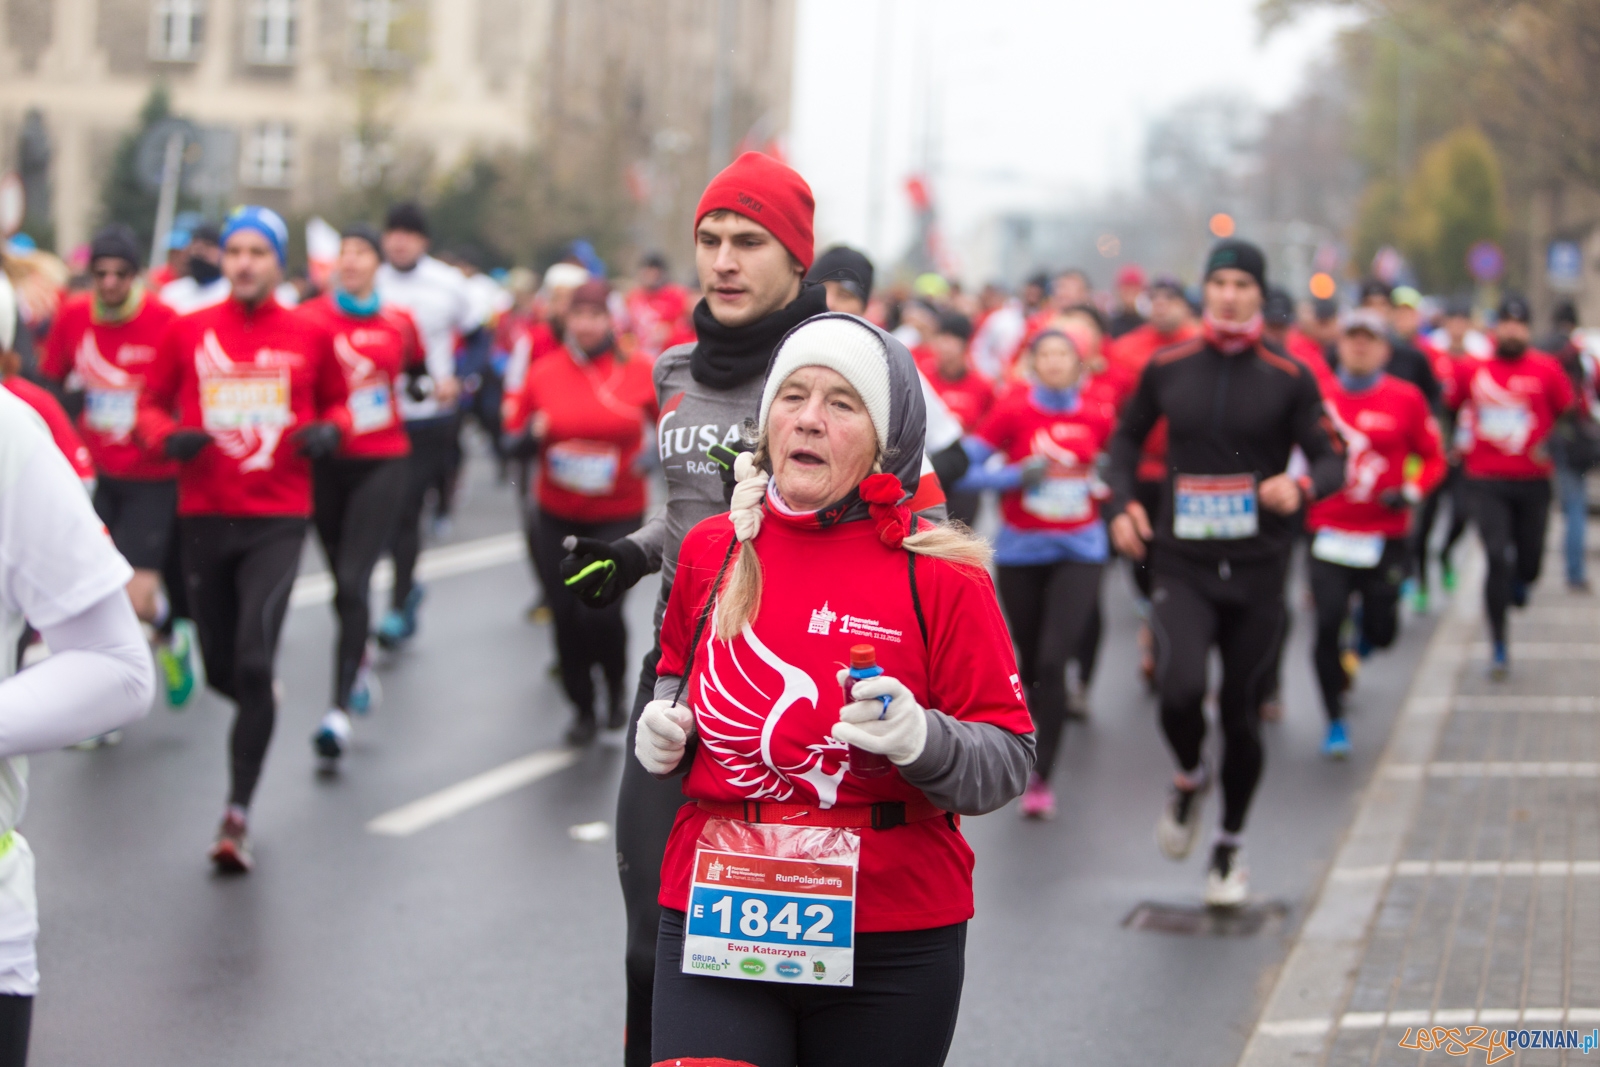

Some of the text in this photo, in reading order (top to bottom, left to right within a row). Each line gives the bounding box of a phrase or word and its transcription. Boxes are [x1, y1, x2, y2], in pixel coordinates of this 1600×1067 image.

[658, 410, 741, 462] HUSA
[686, 461, 720, 474] RAC
[839, 614, 850, 633] 1
[725, 865, 733, 879] 1
[775, 873, 842, 888] RunPoland.org
[693, 895, 834, 942] E 1842
[727, 943, 807, 958] Ewa Katarzyna
[691, 961, 721, 971] LUXMED
[692, 954, 717, 963] GRUPA
